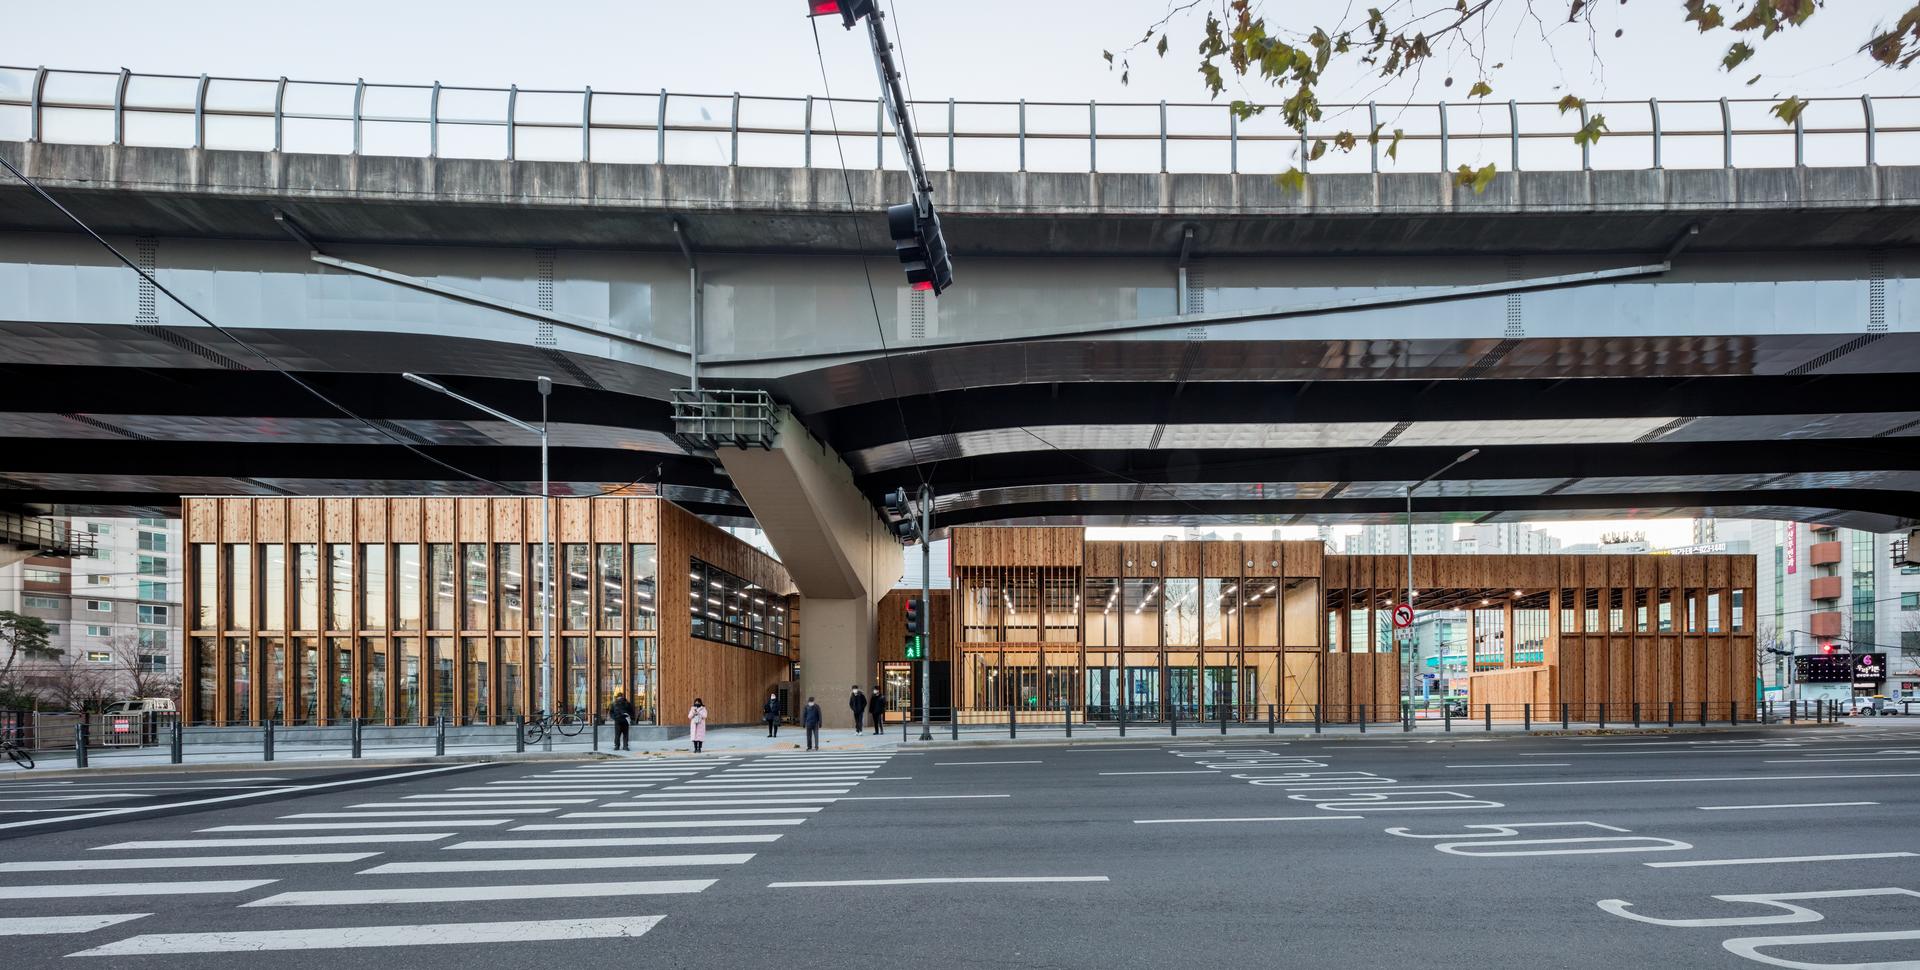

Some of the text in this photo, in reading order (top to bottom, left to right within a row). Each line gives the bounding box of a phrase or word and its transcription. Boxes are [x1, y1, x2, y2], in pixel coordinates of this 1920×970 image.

[1195, 759, 1328, 769] 50
[1231, 771, 1398, 785] 50
[1287, 791, 1505, 811] 50
[1384, 821, 1693, 856] 50
[1596, 887, 1920, 970] 50
